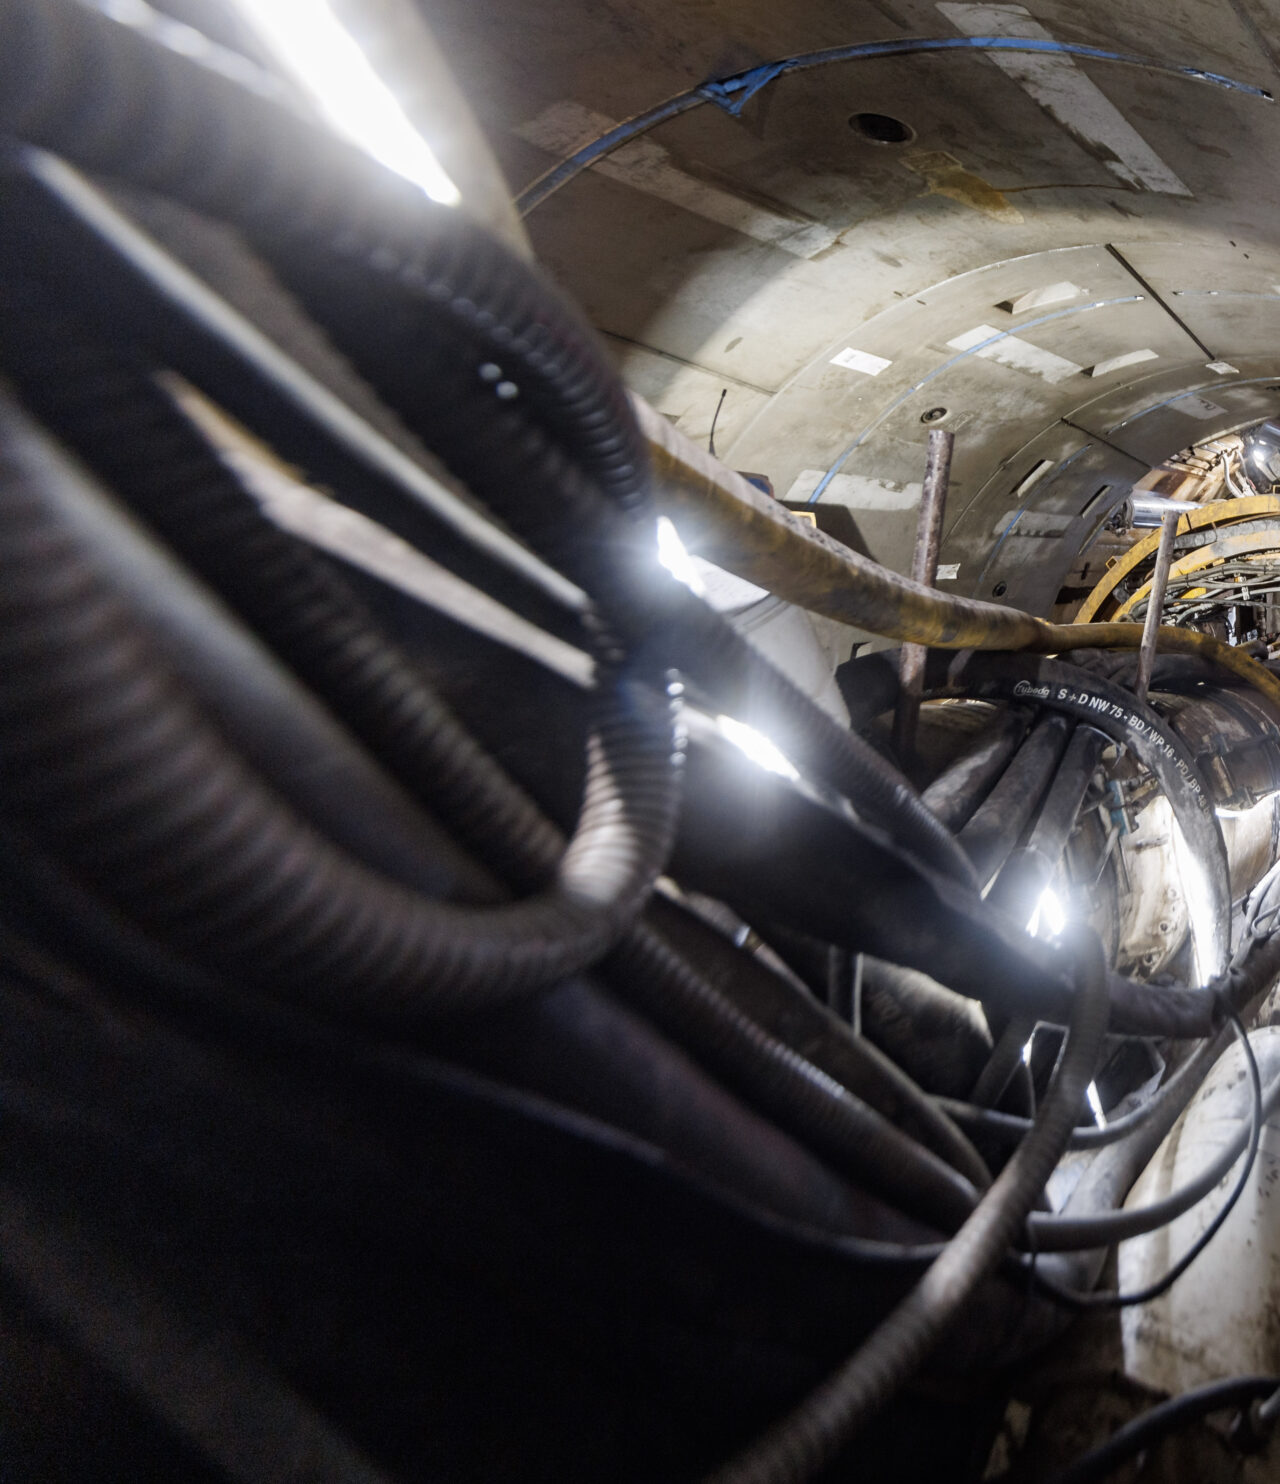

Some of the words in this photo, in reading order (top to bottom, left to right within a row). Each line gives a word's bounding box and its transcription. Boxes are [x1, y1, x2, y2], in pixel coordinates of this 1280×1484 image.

[1058, 689, 1067, 699] S
[1078, 693, 1089, 704] D
[1088, 697, 1110, 712] NW
[1109, 704, 1124, 718] 75
[1163, 744, 1175, 758] 16
